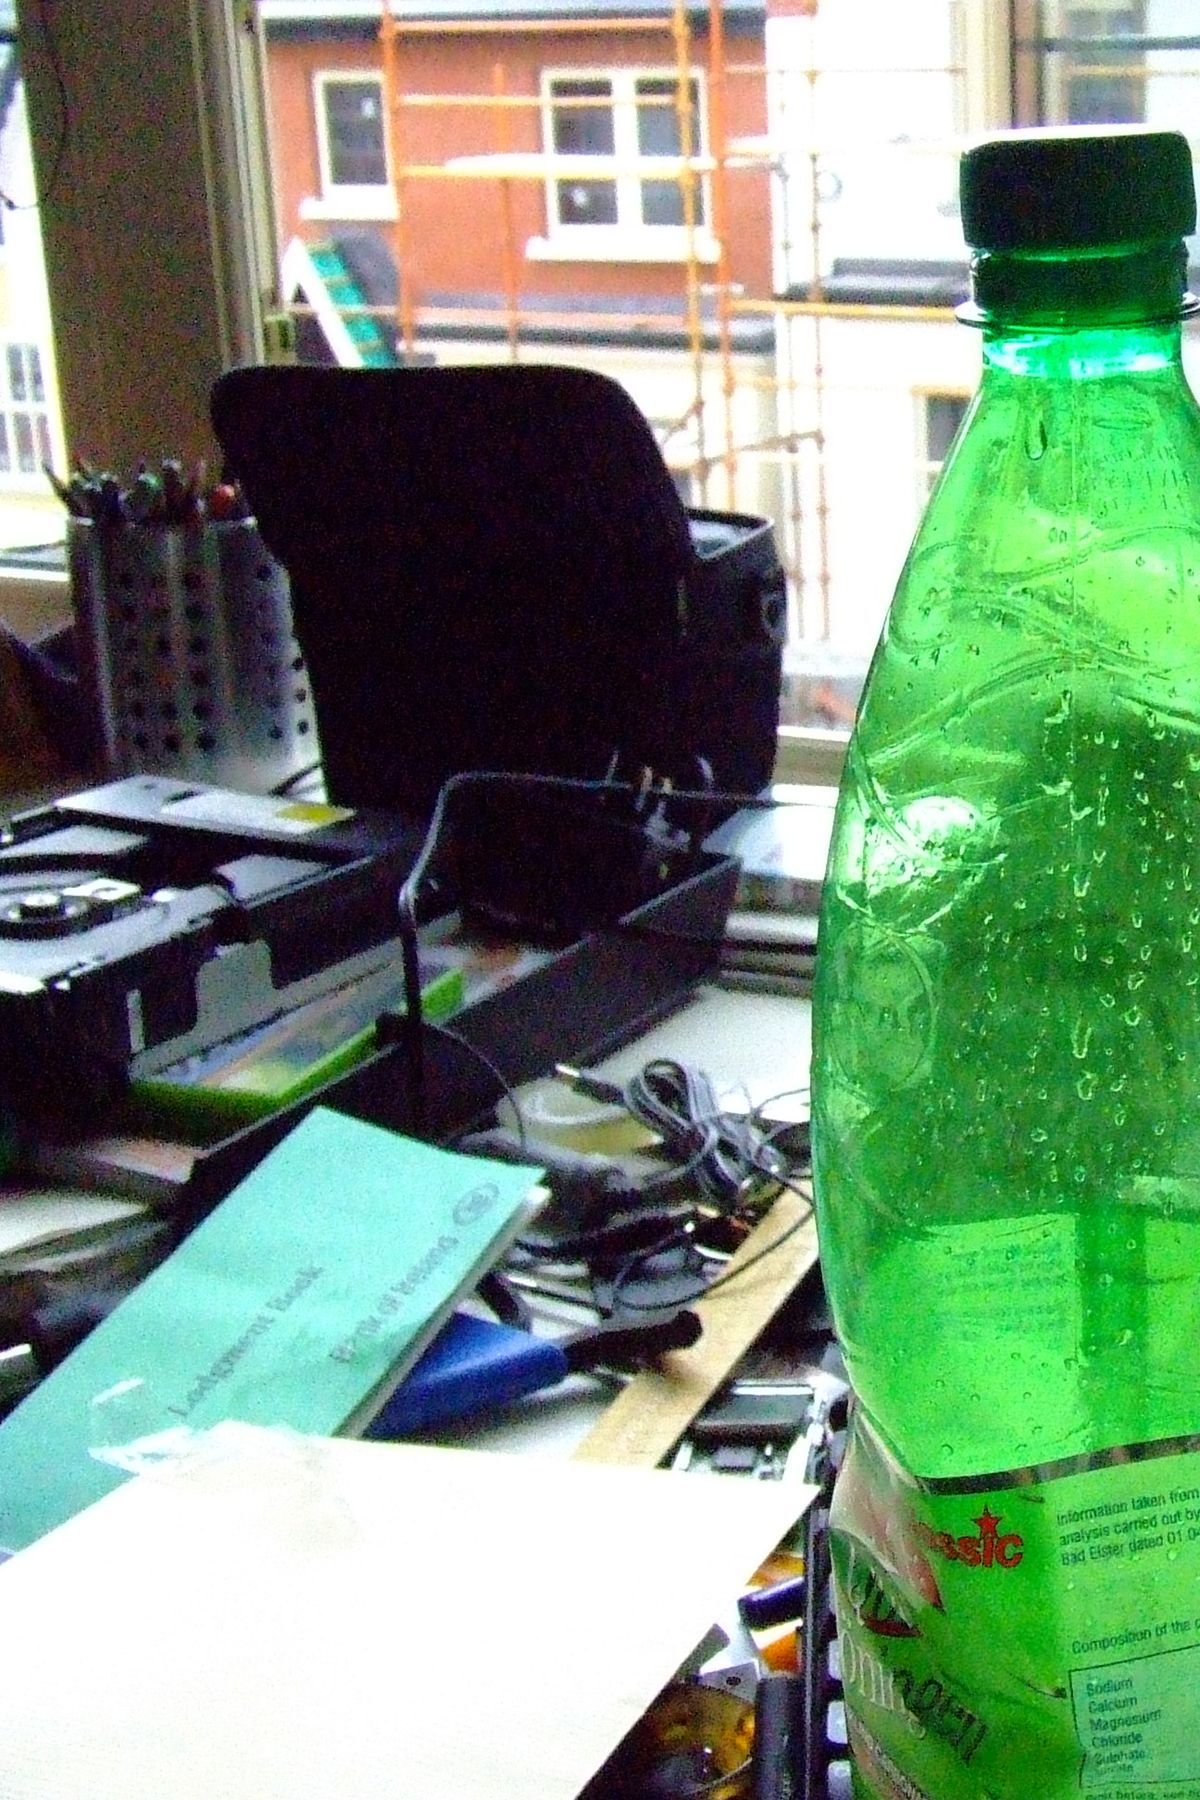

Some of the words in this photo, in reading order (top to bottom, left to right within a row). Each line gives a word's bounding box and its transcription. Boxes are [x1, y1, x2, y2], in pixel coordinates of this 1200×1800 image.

[1056, 1500, 1128, 1526] Information
[1131, 1493, 1166, 1511] taken
[1169, 1486, 1200, 1504] from
[1058, 1523, 1111, 1546] analysis
[1113, 1515, 1158, 1534] carried
[1161, 1510, 1183, 1526] out
[1184, 1507, 1200, 1522] by
[1060, 1550, 1087, 1566] Bad
[1128, 1533, 1164, 1552] dated
[1071, 1629, 1152, 1655] Composition
[1155, 1622, 1170, 1637] of
[1170, 1619, 1192, 1634] the
[1085, 1676, 1134, 1697] Sodium
[1088, 1695, 1138, 1715] Calcium
[1088, 1708, 1163, 1732] Magnesium
[1091, 1730, 1144, 1750] Chloride
